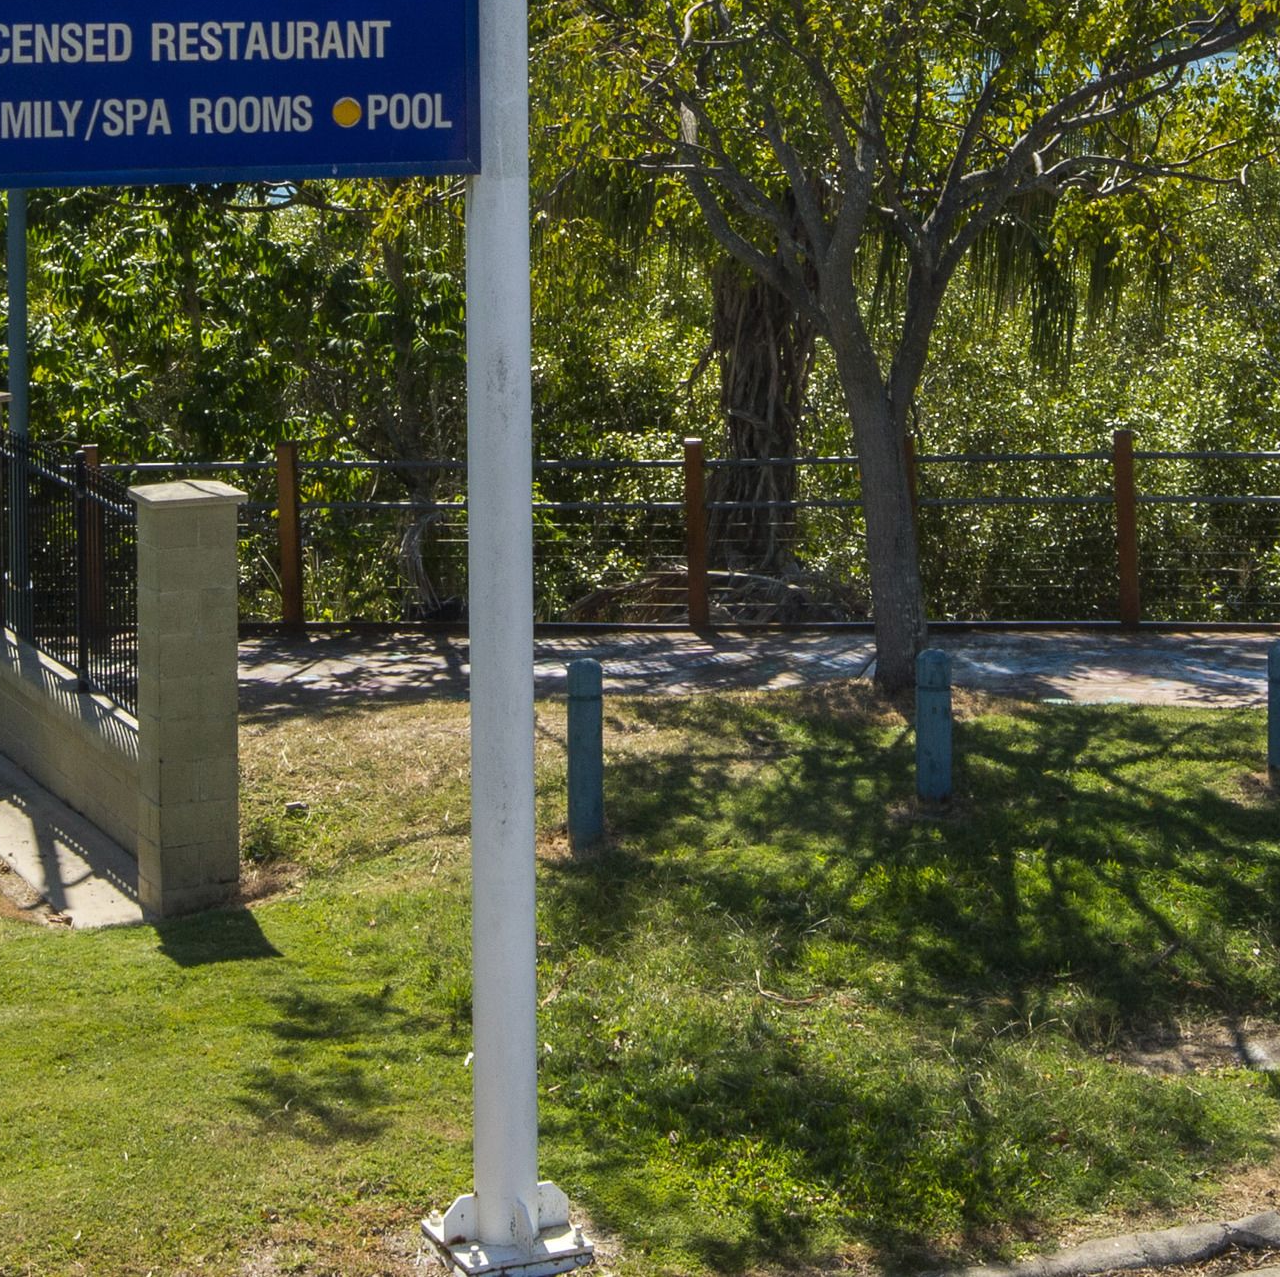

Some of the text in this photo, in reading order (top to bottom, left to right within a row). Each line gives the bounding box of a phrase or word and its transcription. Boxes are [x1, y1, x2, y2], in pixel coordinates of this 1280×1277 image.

[151, 20, 393, 62] RESTAURANT
[190, 95, 314, 135] ROOMS
[368, 93, 454, 131] POOL
